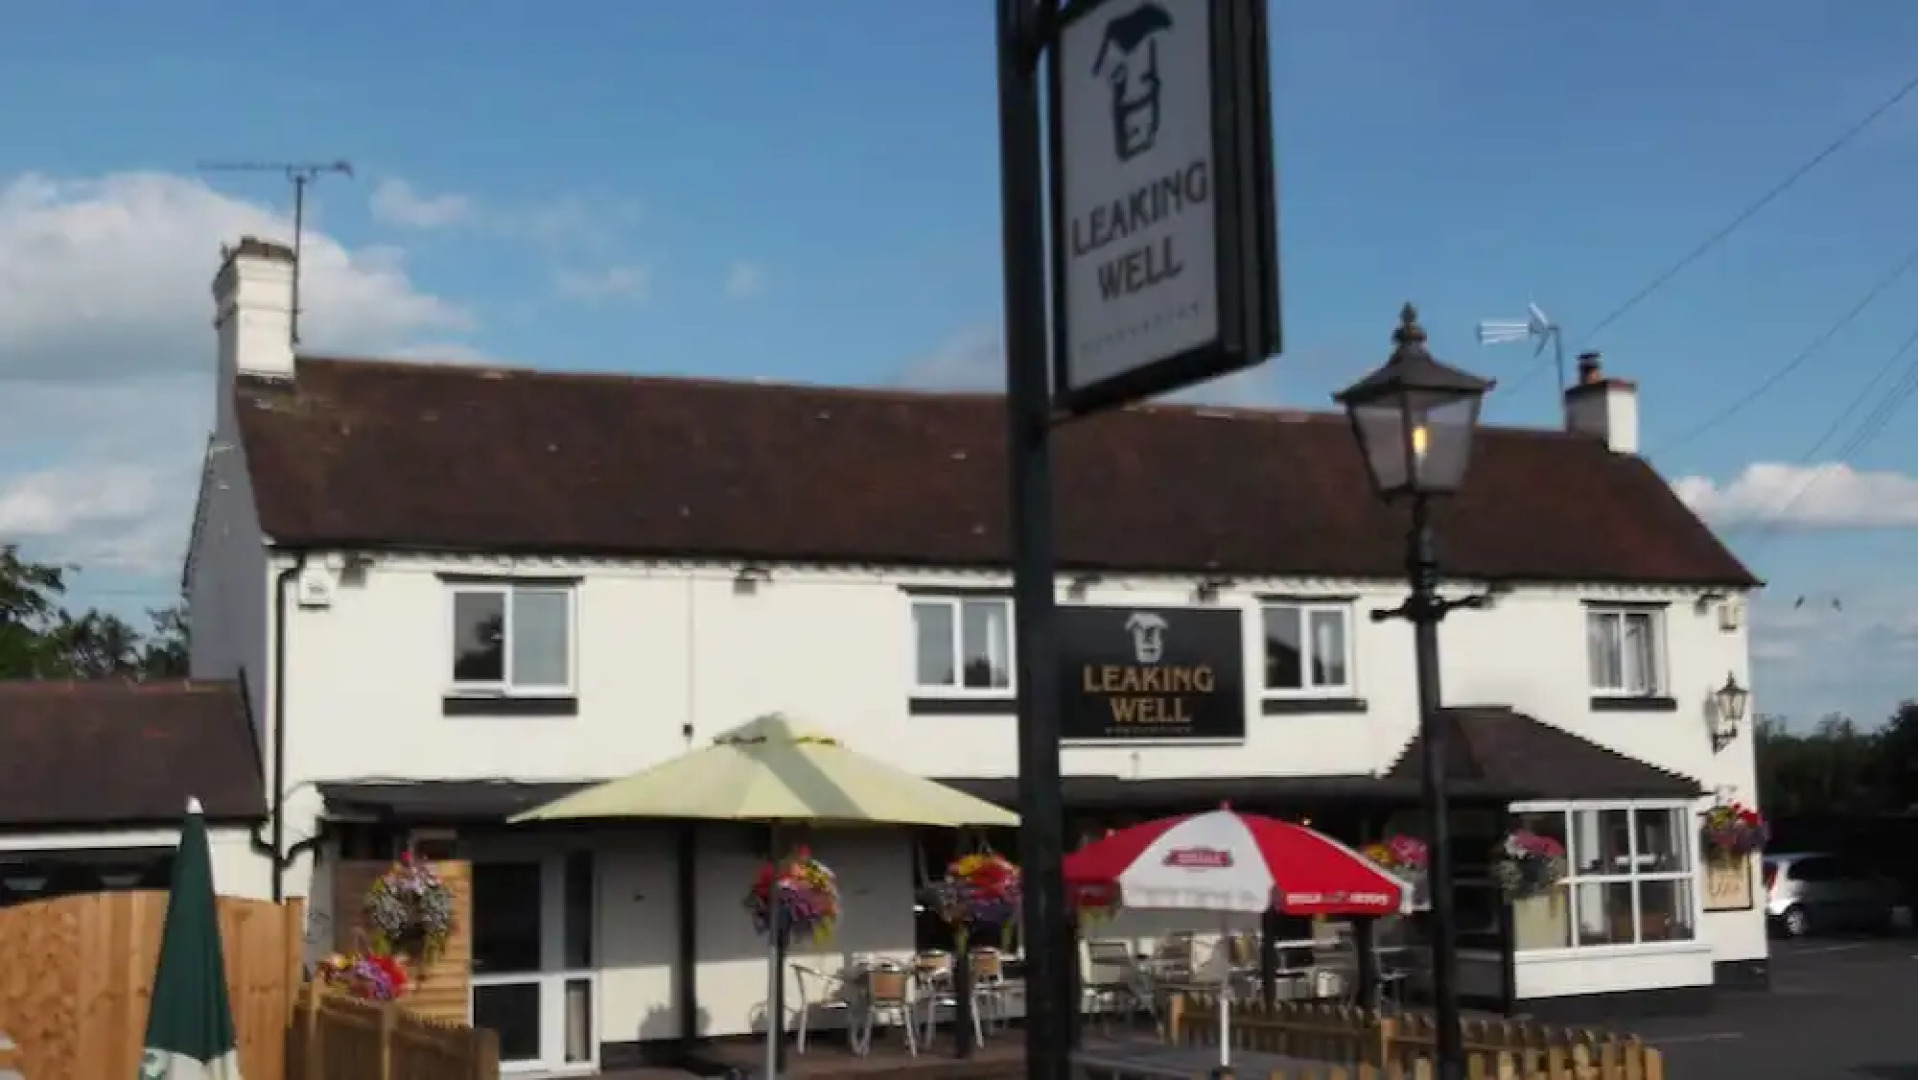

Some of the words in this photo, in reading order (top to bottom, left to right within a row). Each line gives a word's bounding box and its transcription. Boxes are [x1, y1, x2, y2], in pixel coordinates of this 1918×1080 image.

[1071, 161, 1208, 257] LEAKING
[1098, 236, 1184, 301] WELL
[1083, 664, 1215, 693] LEAKING
[1109, 697, 1192, 722] WELL
